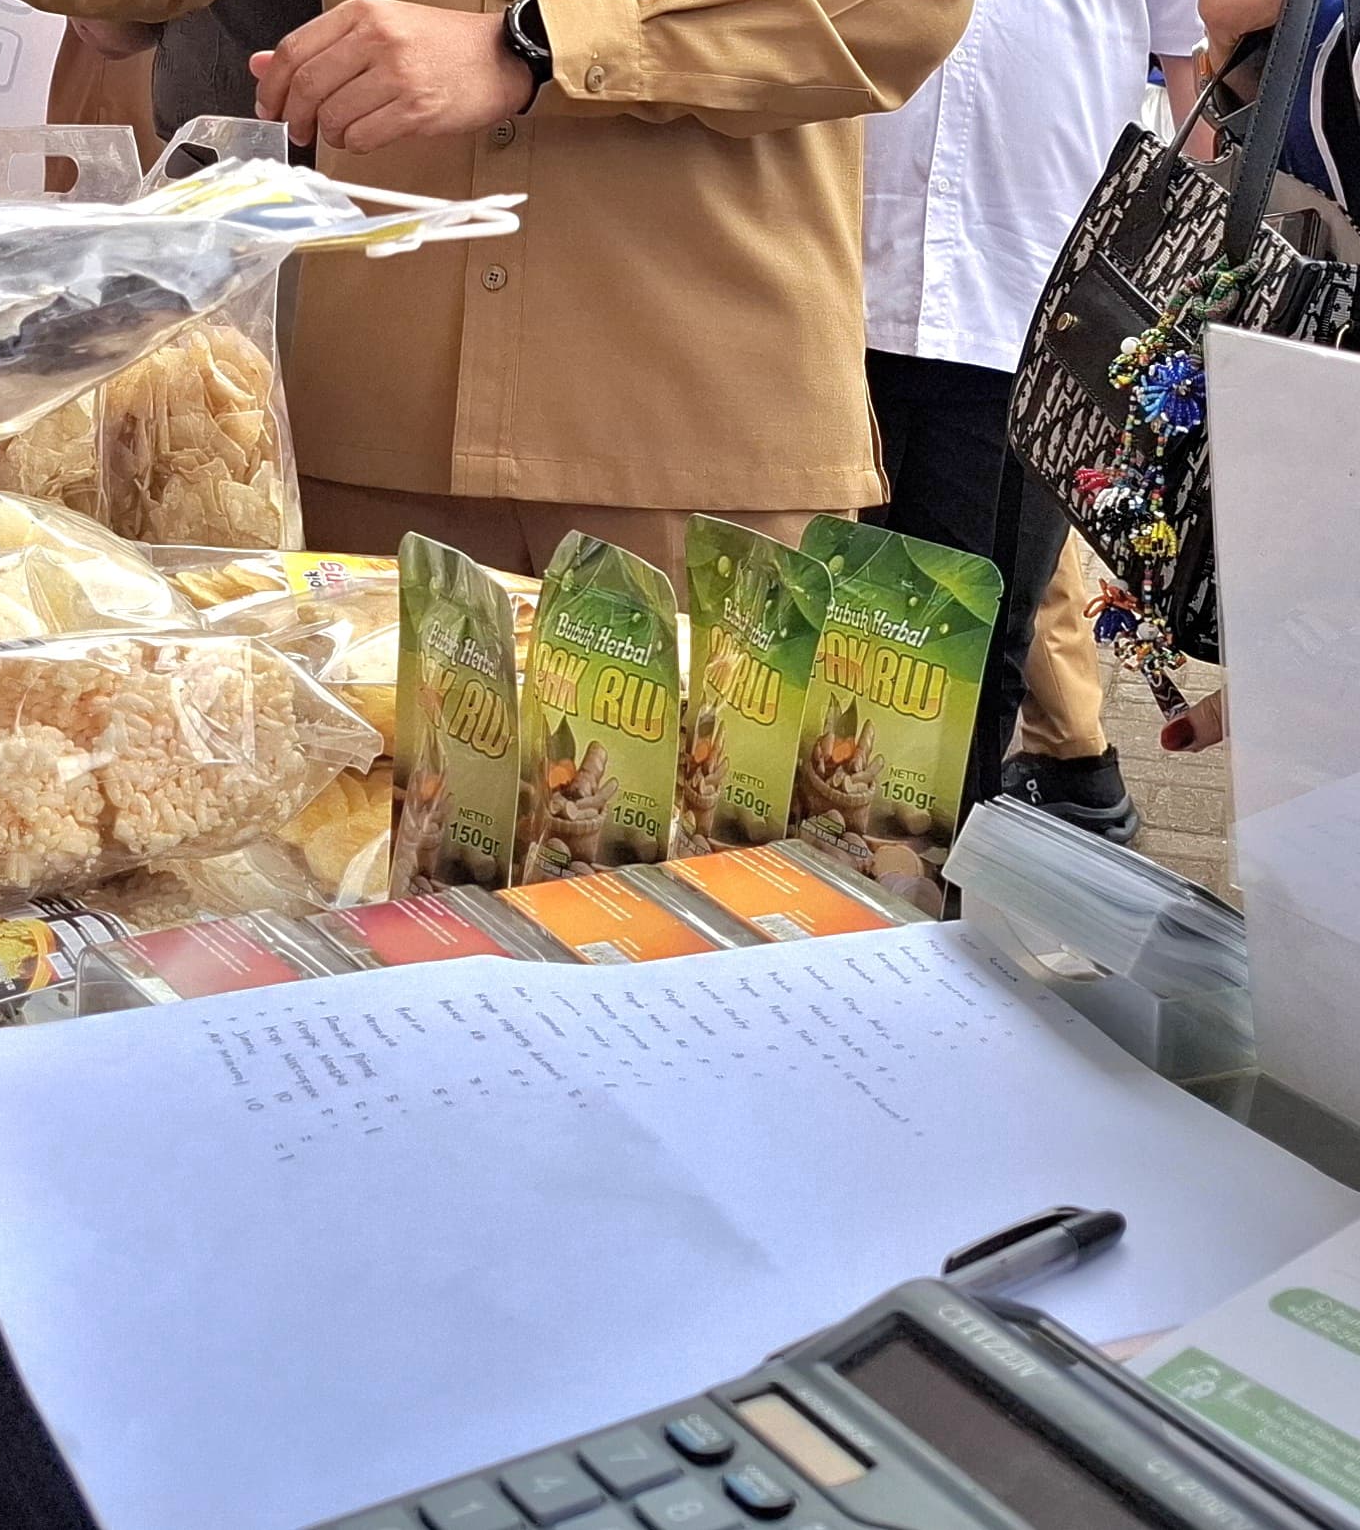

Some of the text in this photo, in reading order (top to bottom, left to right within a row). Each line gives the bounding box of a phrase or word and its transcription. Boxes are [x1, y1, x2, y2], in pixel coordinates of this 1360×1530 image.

[554, 612, 654, 667] Bubuk Herbal
[871, 609, 931, 650] Herbal
[726, 650, 783, 727] RW
[869, 646, 949, 722] RW
[447, 680, 512, 760] RW
[591, 664, 668, 744] RW
[732, 770, 765, 791] NETTO
[889, 766, 927, 784] NETTO
[622, 790, 658, 809] NETTO
[723, 783, 772, 818] 150gr
[880, 780, 938, 811] 150gr
[457, 806, 495, 827] NETTO
[611, 804, 662, 838] 150gr
[448, 821, 501, 857] 150gr
[937, 1303, 1042, 1379] CITIZEN
